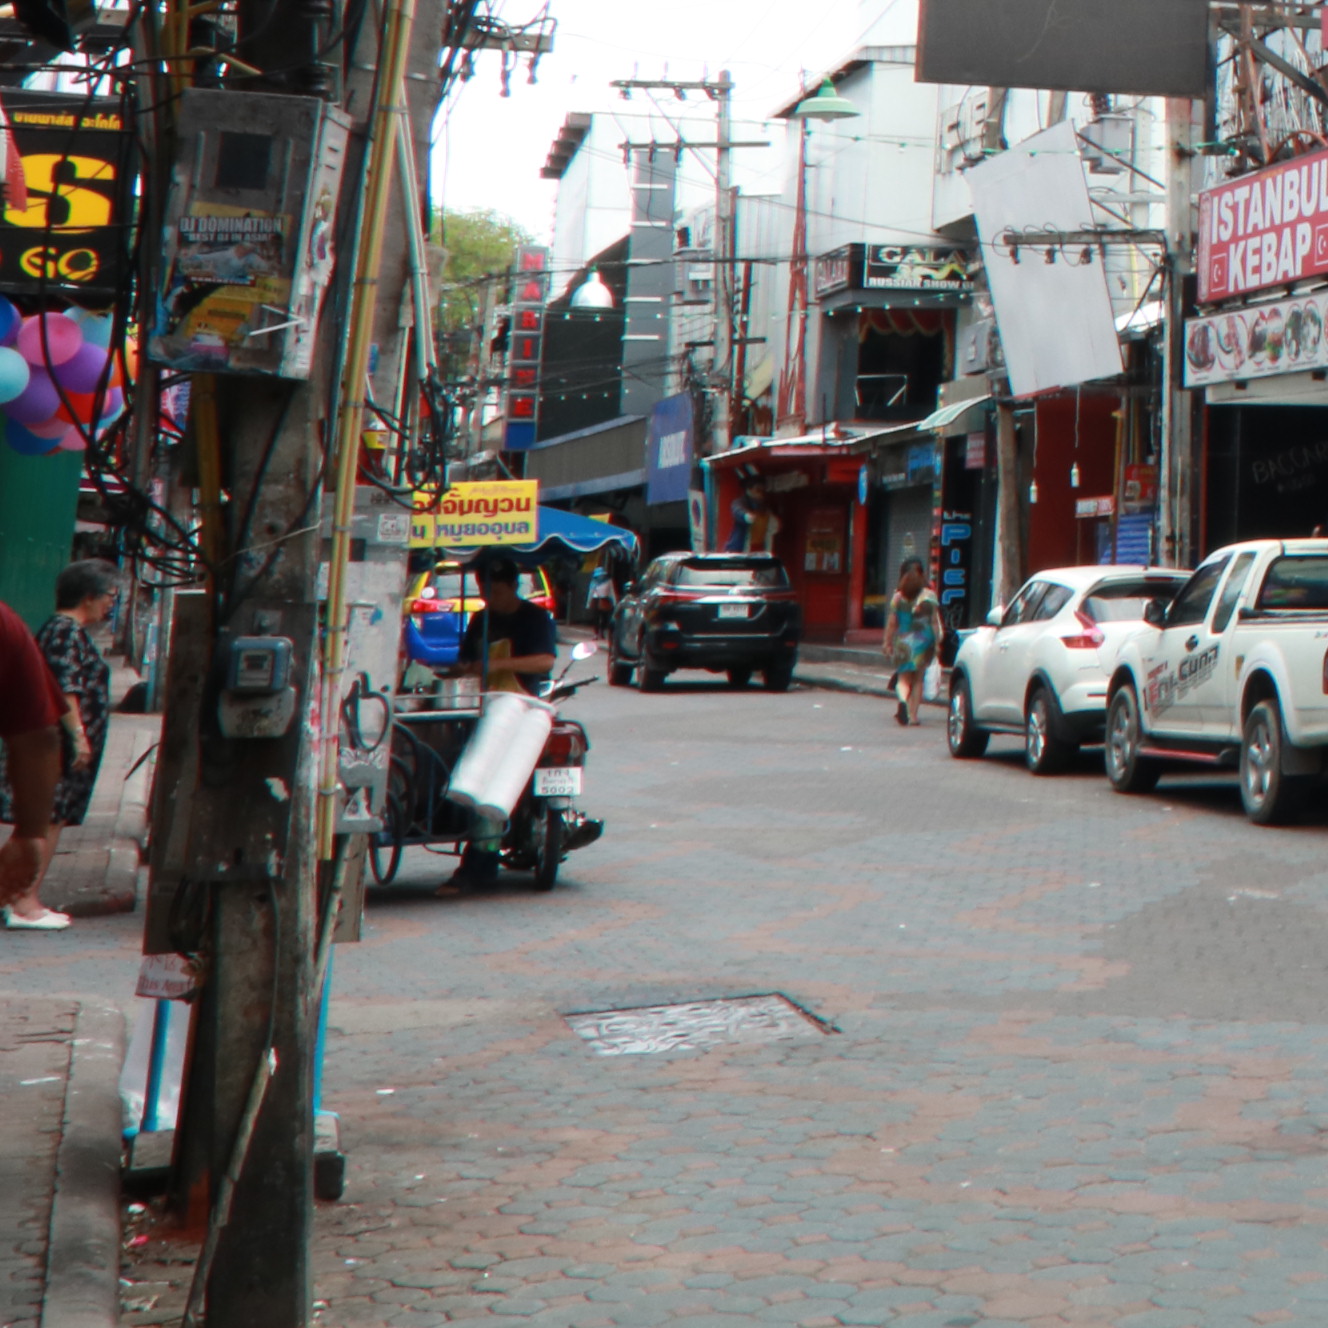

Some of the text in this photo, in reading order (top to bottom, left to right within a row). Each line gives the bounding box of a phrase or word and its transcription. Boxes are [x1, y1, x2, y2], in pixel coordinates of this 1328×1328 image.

[198, 217, 283, 233] DOMINATION
[1228, 221, 1313, 293] KEBAP
[869, 276, 922, 288] RUSSIAN
[512, 252, 545, 417] MARINE
